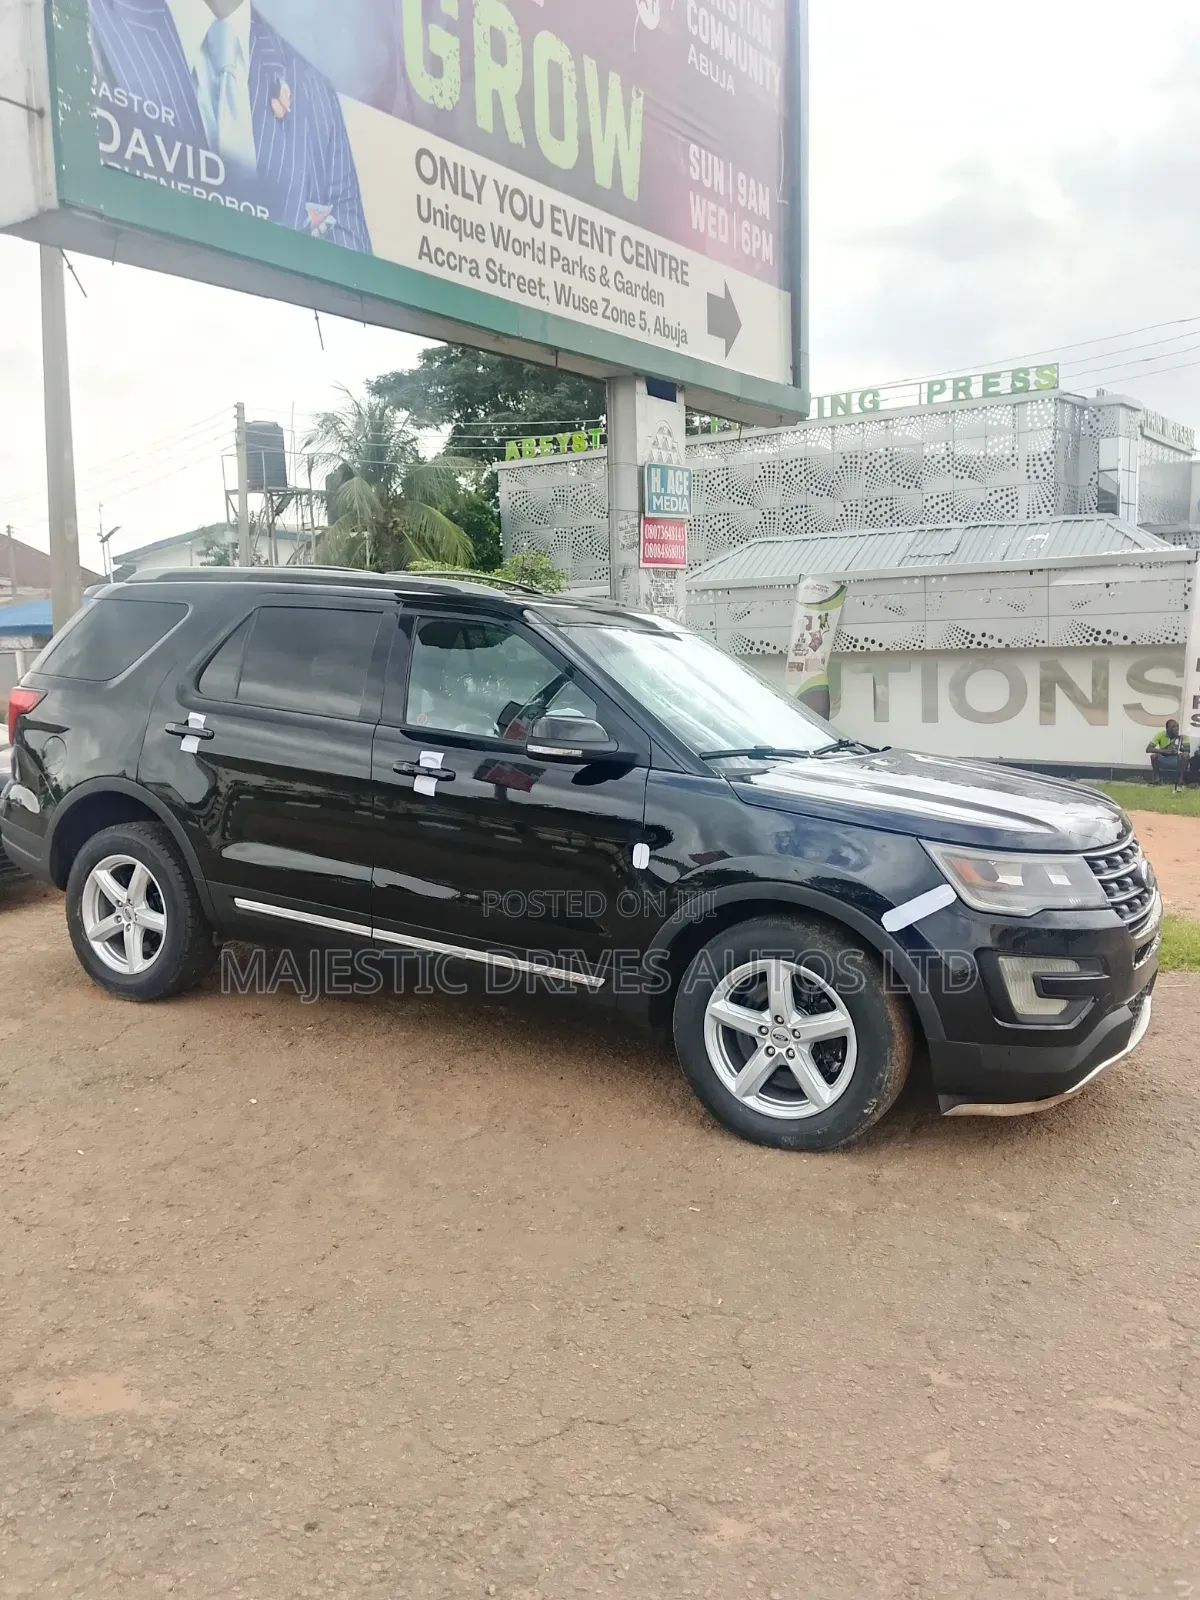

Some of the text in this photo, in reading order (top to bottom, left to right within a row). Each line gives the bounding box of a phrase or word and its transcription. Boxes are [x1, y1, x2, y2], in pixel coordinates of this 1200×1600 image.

[687, 0, 781, 97] COMMUNITY
[688, 43, 736, 95] ABUJA
[402, 0, 645, 202] GROW
[96, 106, 226, 186] DAVID
[689, 143, 724, 196] SUN
[738, 171, 770, 221] 9AM
[414, 147, 690, 287] ONLY YOU EVENT CENTRE
[416, 194, 665, 308] Unique World Parks & Garden
[689, 190, 729, 244] WED
[741, 219, 774, 266] 6PM
[418, 235, 689, 346] Accra Street, Wuse Zone 5, Abuja
[926, 363, 1058, 405] PRESS
[651, 467, 690, 496] H. ACE
[652, 494, 690, 512] MEDIA
[828, 653, 1184, 728] TIONS
